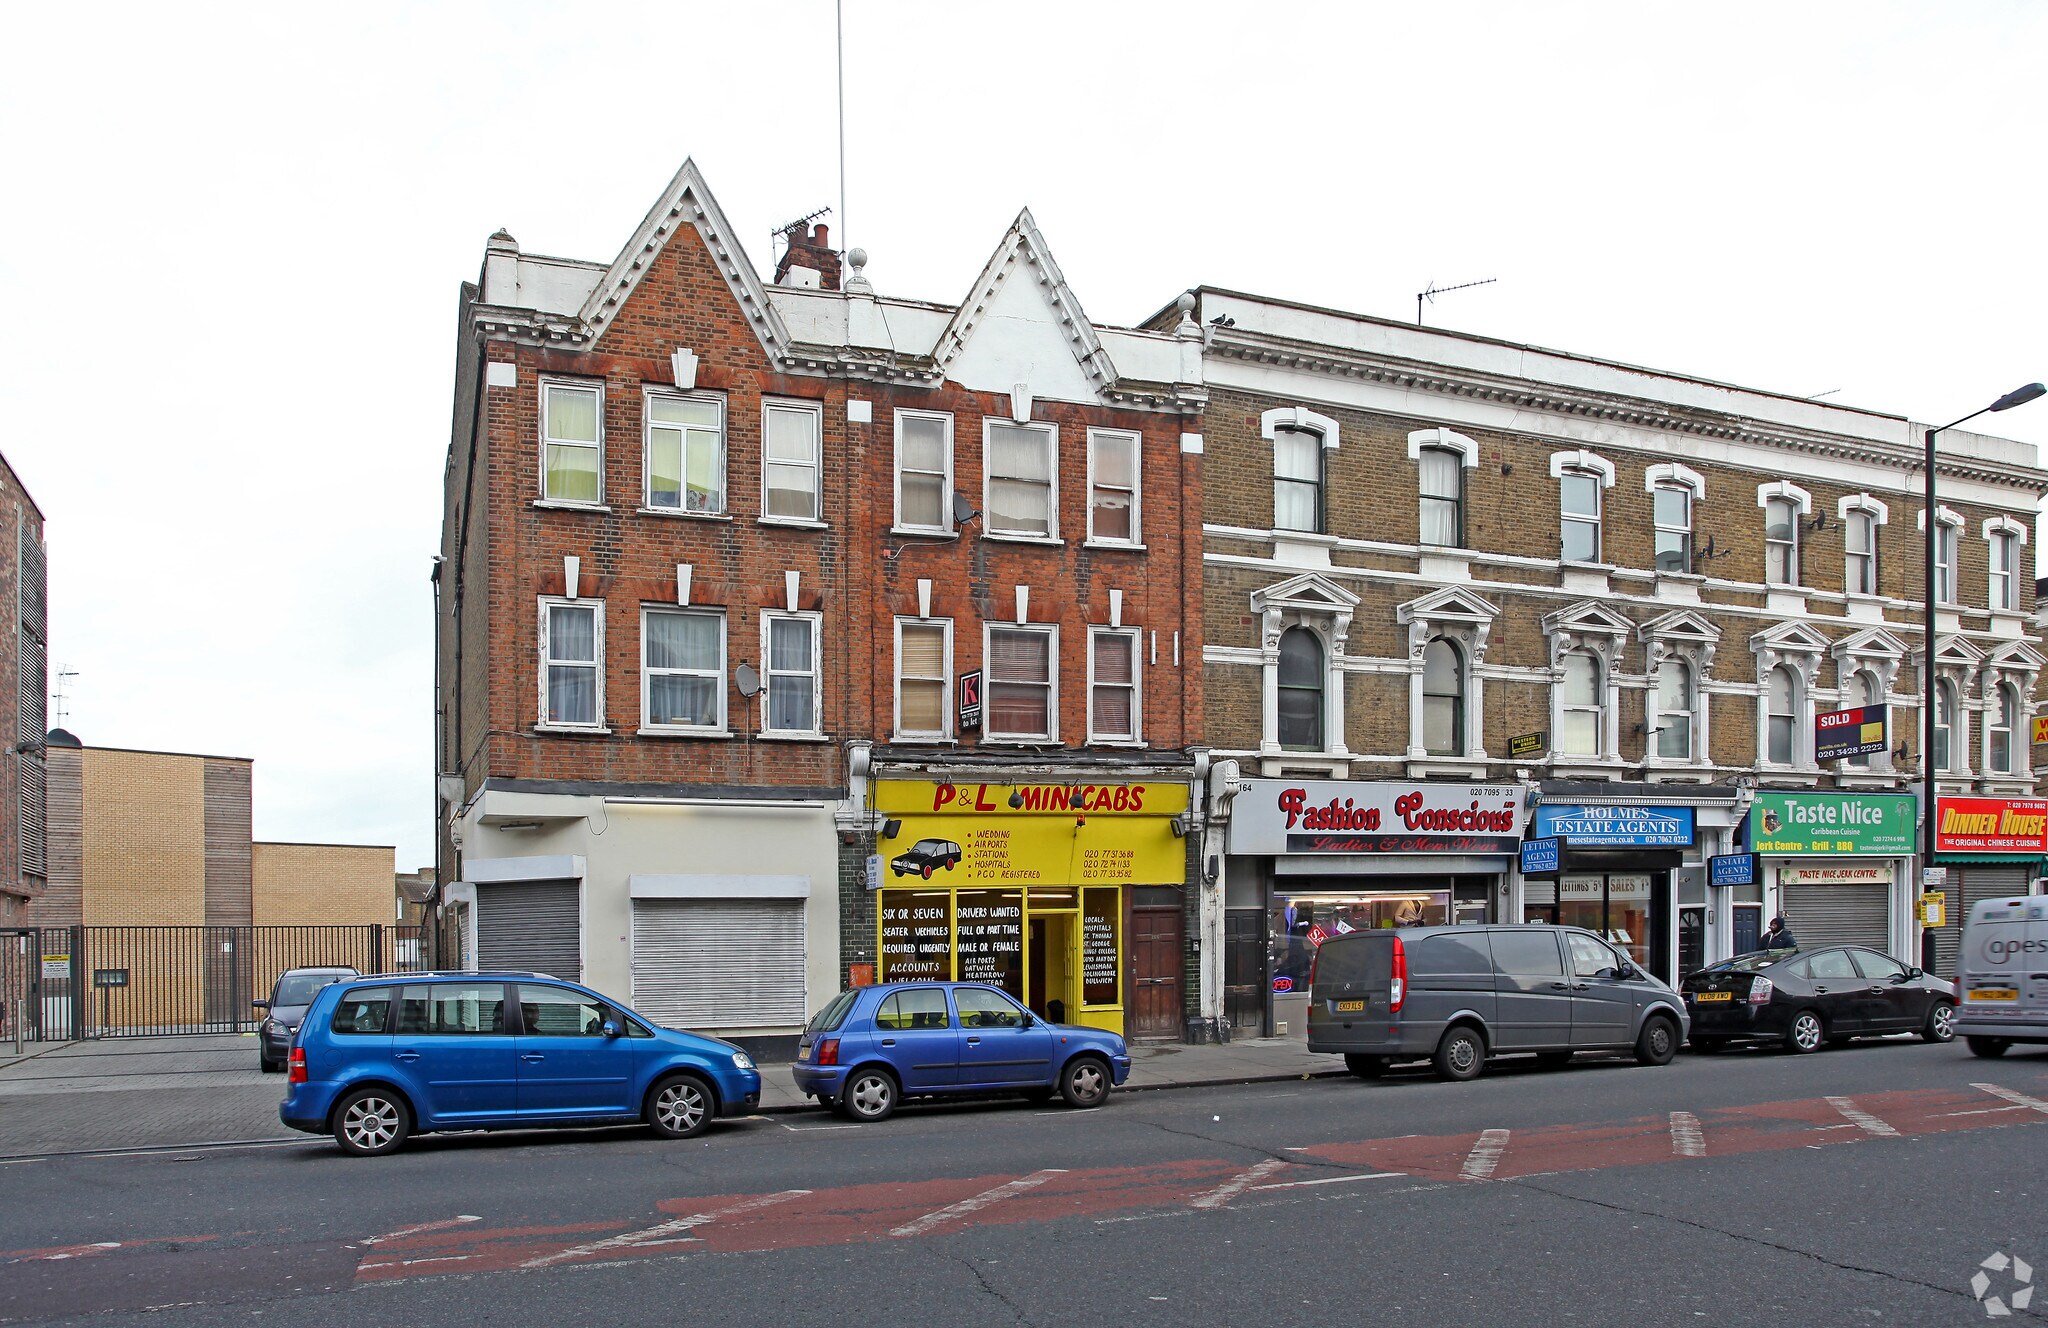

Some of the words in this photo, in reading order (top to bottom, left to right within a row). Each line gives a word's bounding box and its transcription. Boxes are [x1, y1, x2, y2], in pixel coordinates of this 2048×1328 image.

[1821, 714, 1850, 727] SOLD
[1837, 747, 1858, 756] 3428
[1861, 744, 1882, 752] 2222
[1239, 784, 1252, 792] 164
[933, 784, 956, 811] P
[958, 788, 972, 806] &
[975, 784, 997, 811] L
[1278, 788, 1380, 831] Fashion
[1394, 791, 1514, 832] Conscious
[1584, 807, 1650, 819] HOLMES
[1784, 800, 1836, 824] Taste
[1842, 800, 1882, 824] Nice
[1940, 808, 1998, 834] DINNER
[1998, 809, 2047, 835] HOUSE
[1555, 821, 1612, 833] ESTATE
[1616, 821, 1676, 833] AGENTS
[976, 830, 1010, 839] WEDDING
[1310, 837, 1373, 851] Ladies
[1380, 838, 1399, 850] &
[1400, 837, 1449, 850] Mens
[1453, 838, 1498, 851] Wear
[1524, 841, 1556, 851] LETTING
[1756, 841, 1773, 851] Jerk
[1774, 841, 1802, 850] Centre
[1812, 841, 1829, 850] Grill
[1837, 841, 1853, 851] BBQ
[974, 850, 1009, 859] STATIONS
[1085, 850, 1098, 858] 020
[1526, 851, 1555, 861] AGENTS
[975, 860, 1011, 868] HOSPITALS
[1084, 860, 1098, 868] 020
[1717, 858, 1747, 866] ESTATE
[977, 870, 995, 878] PCO
[1001, 870, 1040, 878] REGISTERED
[1716, 867, 1749, 875] AGENTS
[1799, 870, 1820, 878] TASTE
[1822, 870, 1836, 878] NICE
[1854, 870, 1877, 878] CENTRE
[1562, 880, 1589, 892] LETTINGS
[1610, 878, 1635, 892] SALES
[882, 908, 895, 920] SIX
[898, 909, 909, 920] OR
[913, 908, 944, 919] SEVEN
[958, 907, 987, 918] DRIVERS
[990, 907, 1019, 918] WANTED
[883, 927, 908, 936] SEATER
[957, 926, 973, 935] FULL
[976, 925, 984, 935] OR
[987, 925, 1001, 934] PART
[1002, 925, 1019, 934] TIME
[883, 944, 915, 953] REQUIRED
[920, 943, 950, 953] URGENTLY
[957, 943, 977, 952] MALE
[980, 943, 988, 952] OR
[992, 942, 1019, 952] FEMALE
[890, 963, 940, 972] ACCOUNTS
